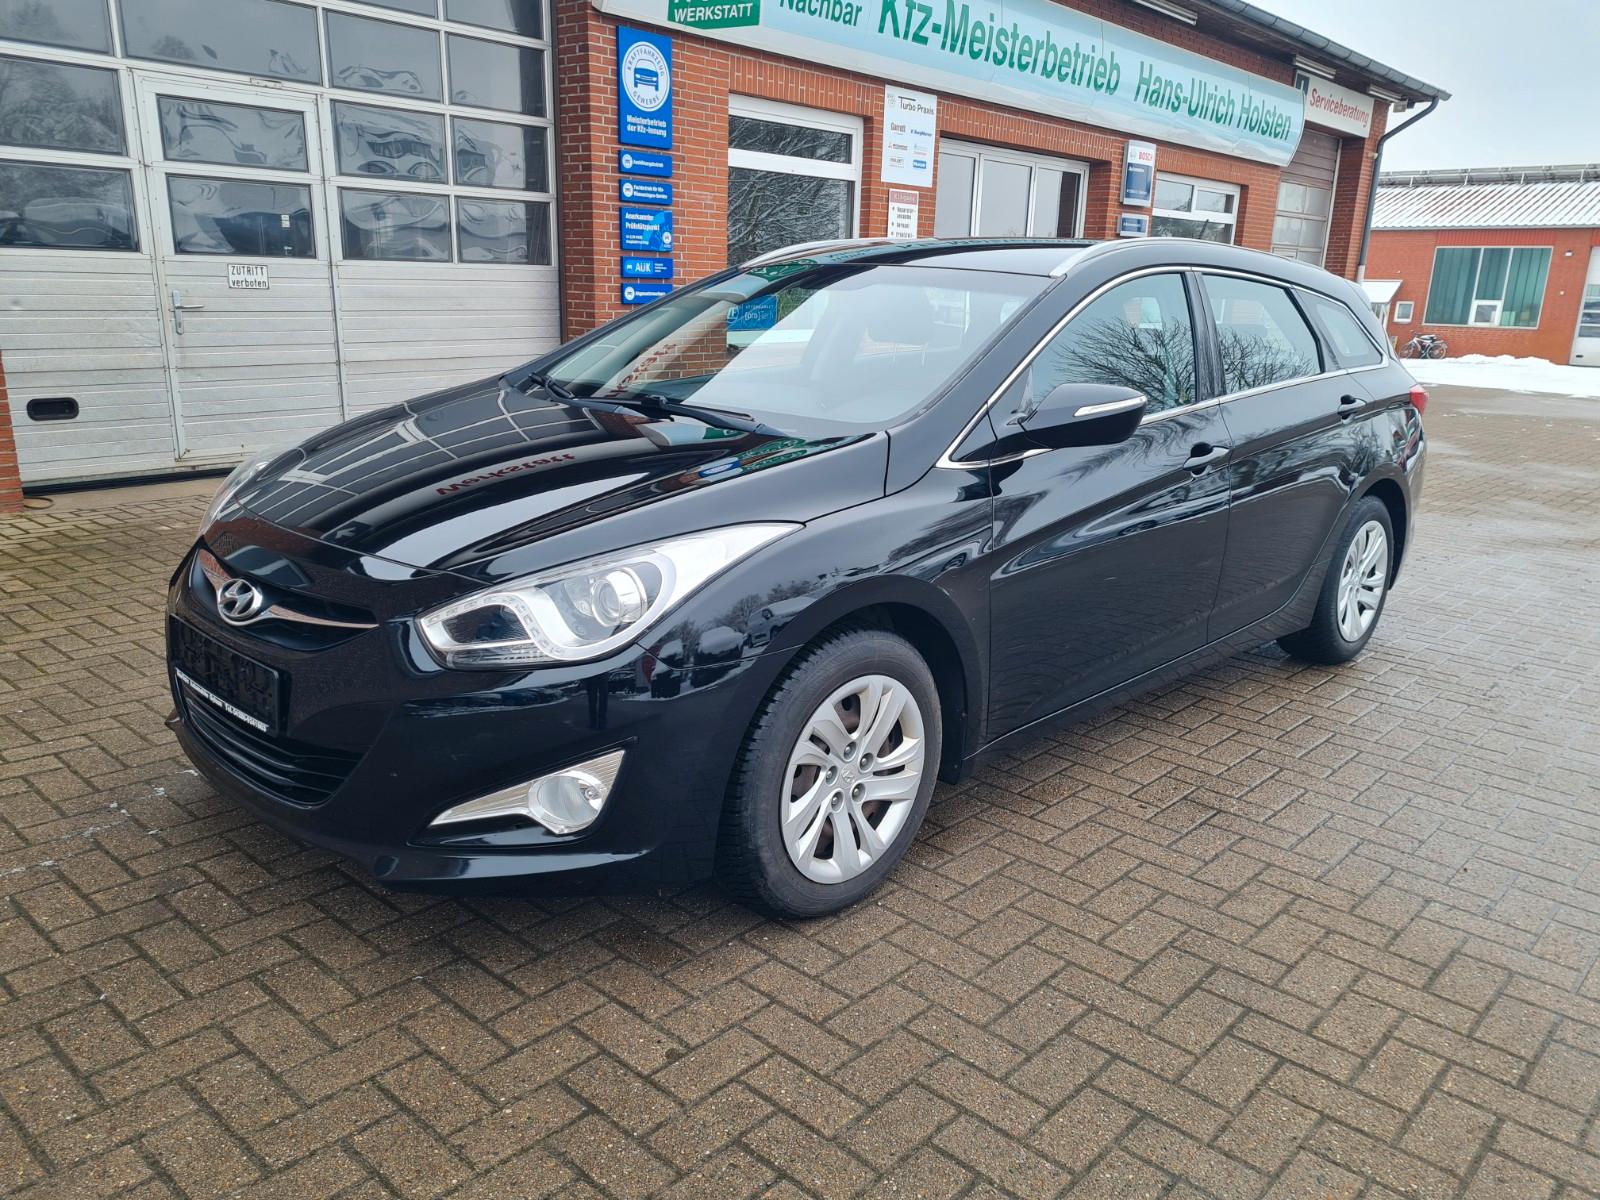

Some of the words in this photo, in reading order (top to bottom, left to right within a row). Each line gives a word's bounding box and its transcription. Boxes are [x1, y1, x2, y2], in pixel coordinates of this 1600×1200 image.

[674, 3, 753, 22] WERKSTATT
[877, 0, 1121, 96] Kfz-Meisterbetrieb
[1133, 60, 1236, 127] Hans-Ulrich
[1236, 92, 1293, 141] Holsten
[1309, 87, 1370, 129] Serviceberatung
[231, 265, 264, 276] ZUTRITT
[231, 277, 267, 288] verboten
